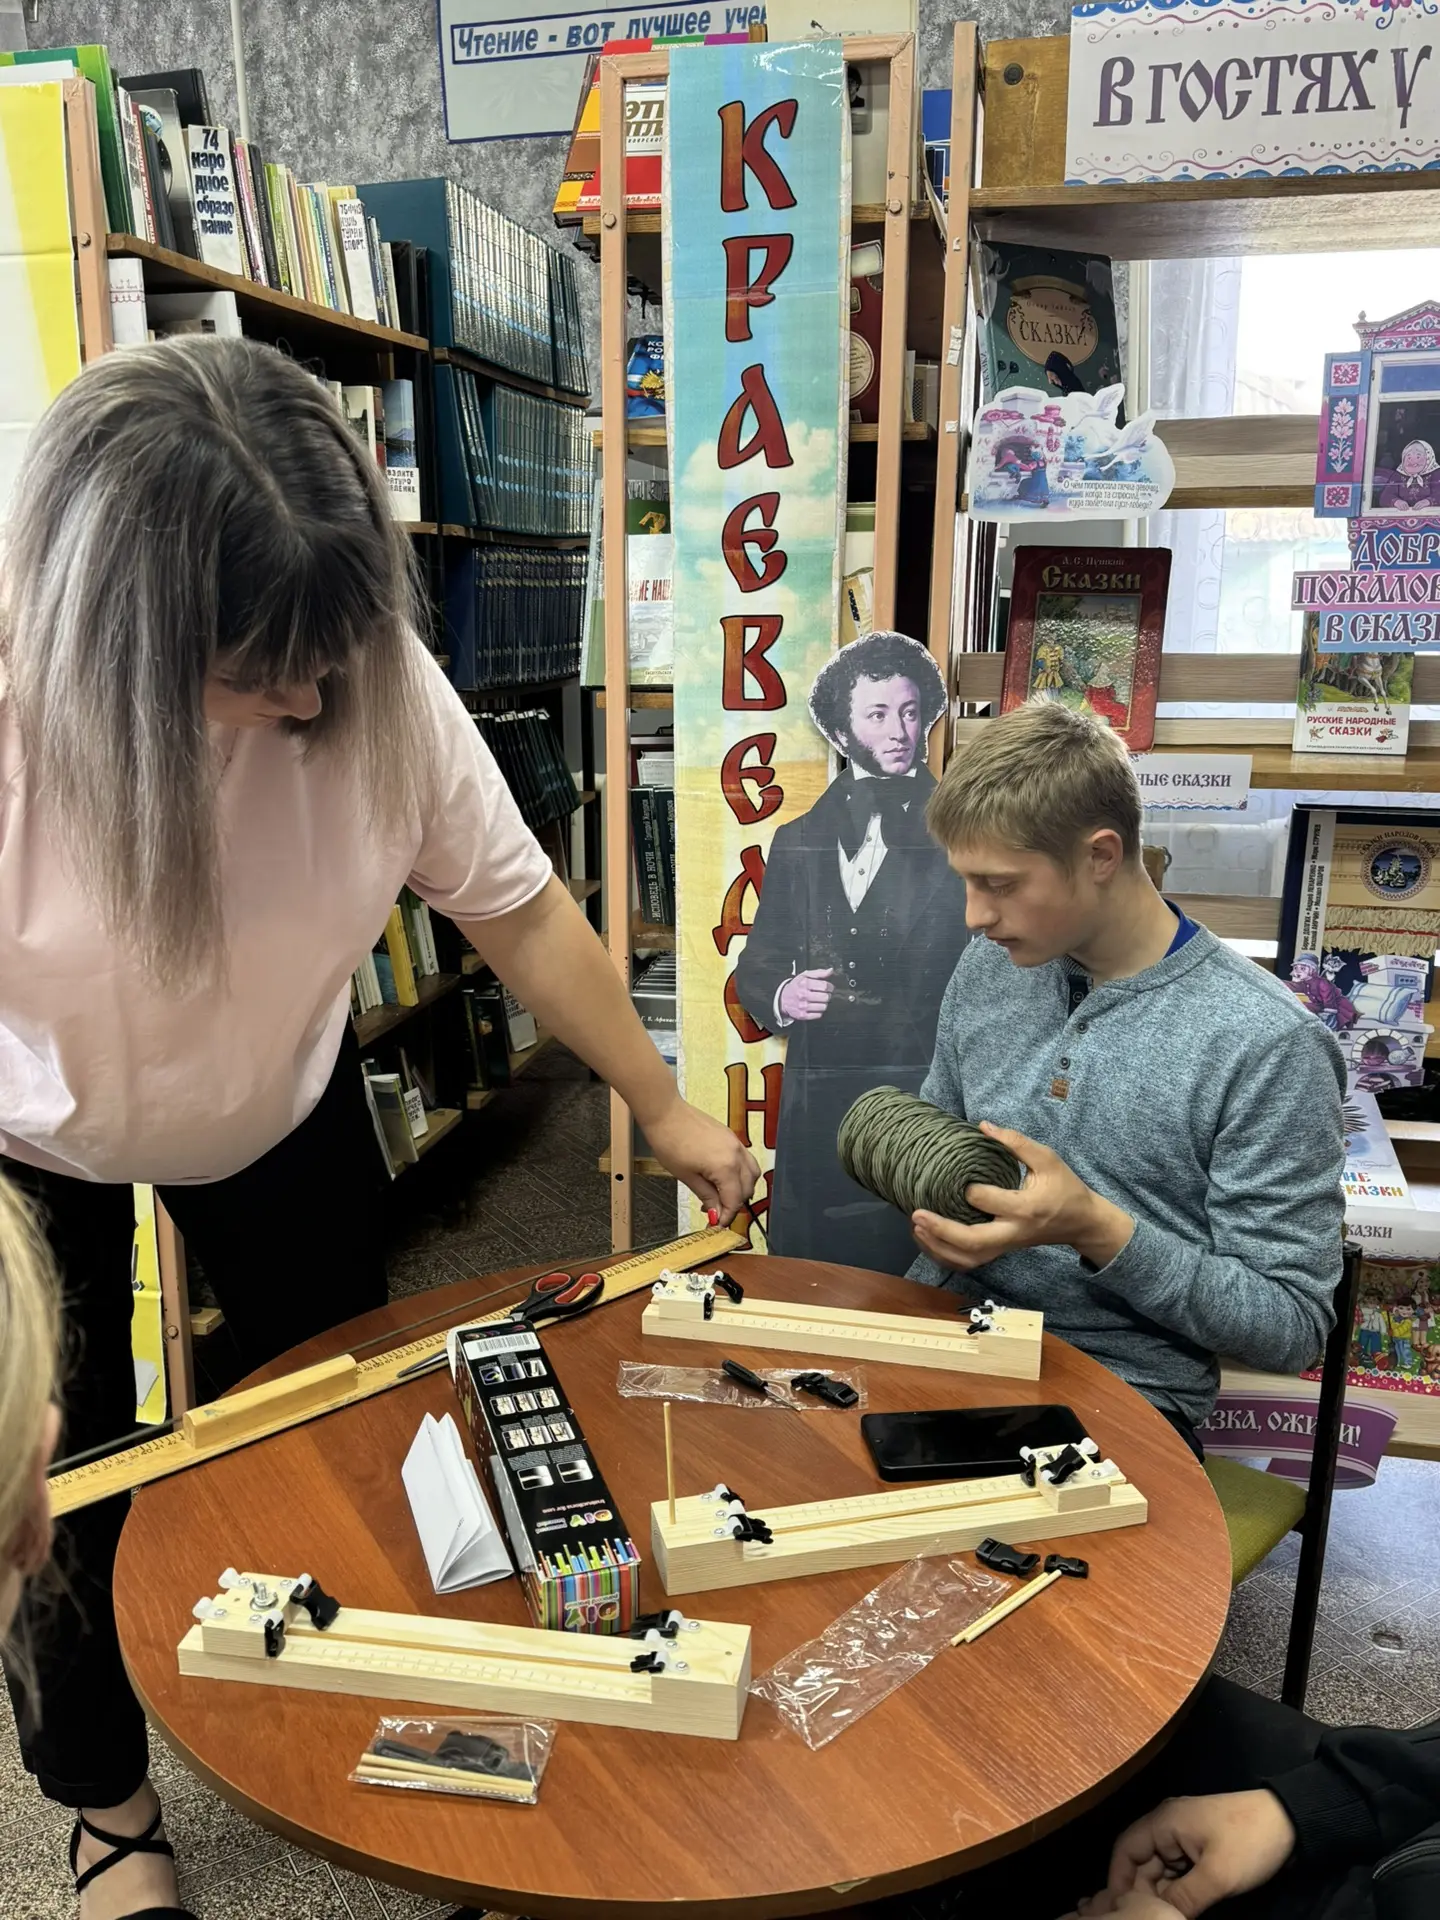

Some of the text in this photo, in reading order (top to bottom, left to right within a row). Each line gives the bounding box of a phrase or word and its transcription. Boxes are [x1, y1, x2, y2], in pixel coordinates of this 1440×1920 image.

[458, 26, 538, 56] Чтение
[566, 22, 616, 47] вот
[626, 11, 712, 40] лучшее
[1093, 56, 1135, 127] В
[1146, 48, 1378, 123] ГОСТЯХ
[202, 129, 219, 151] 74
[191, 152, 225, 174] наро
[195, 175, 229, 194] дное
[197, 195, 234, 218] образо
[201, 219, 233, 235] вание
[1020, 319, 1088, 346] СКАЗКИ
[1353, 529, 1440, 572] ДОБР
[1323, 613, 1345, 643] В
[1307, 716, 1397, 726] РУССКИЕ НАРОДНЫЕ
[1328, 726, 1372, 737] СКАЗКИ
[1136, 773, 1232, 789] НЫЕ СКАЗКИ
[645, 851, 656, 872] НОЧИ
[648, 881, 661, 918] ИСПОВЕДЬ
[1344, 1184, 1403, 1197] КАЗКИ
[1345, 1223, 1392, 1239] КАЗКИ
[1194, 1409, 1362, 1447] АЗКА, ОЖИИ!
